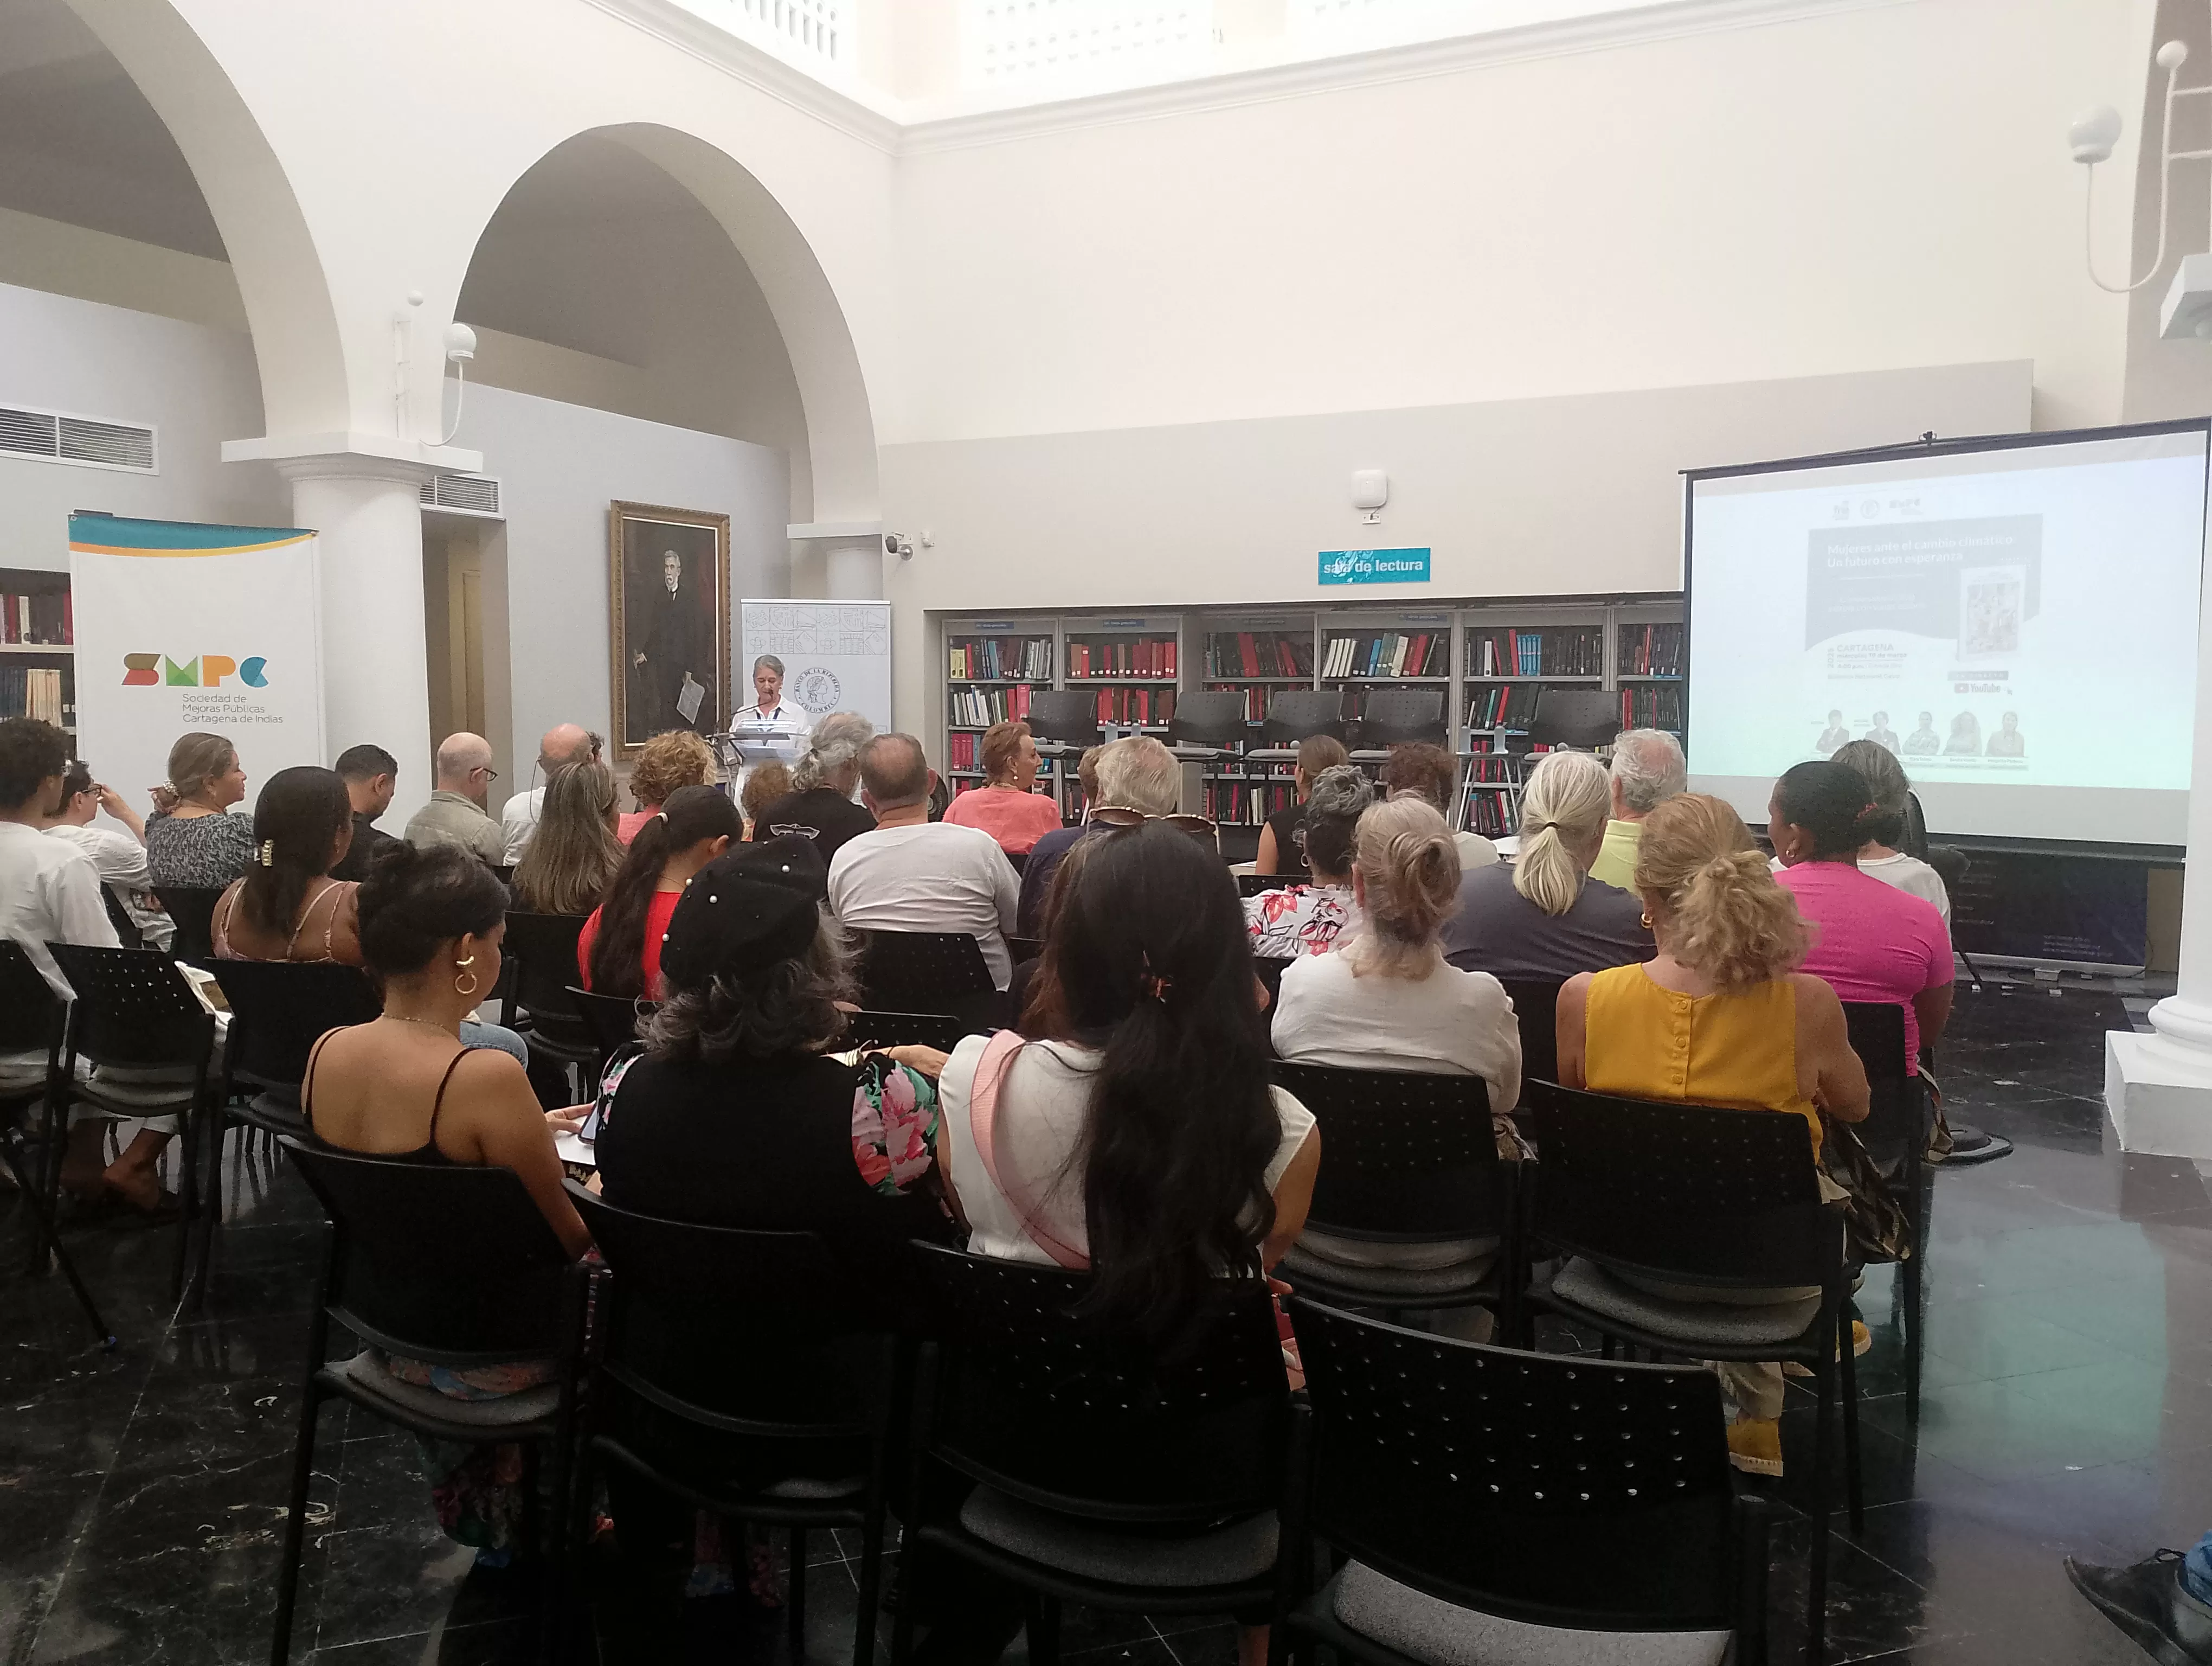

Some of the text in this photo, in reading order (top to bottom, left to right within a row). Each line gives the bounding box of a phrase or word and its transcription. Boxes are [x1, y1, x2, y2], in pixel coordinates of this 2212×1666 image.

[1828, 535, 2013, 556] Mujeres ante el cambio climático
[1828, 553, 1963, 567] Un futuro con esperanza
[1355, 561, 1372, 573] de
[1375, 559, 1423, 572] lectura
[1837, 644, 1894, 652] CARTAGENA
[121, 653, 269, 688] SMPC
[1971, 683, 2001, 693] YouTube
[183, 694, 230, 702] Sociedad
[182, 704, 265, 714] Mejoras Públicas
[801, 702, 834, 712] COLOMBIA
[183, 714, 237, 724] Cartagena
[256, 715, 283, 723] Indias
